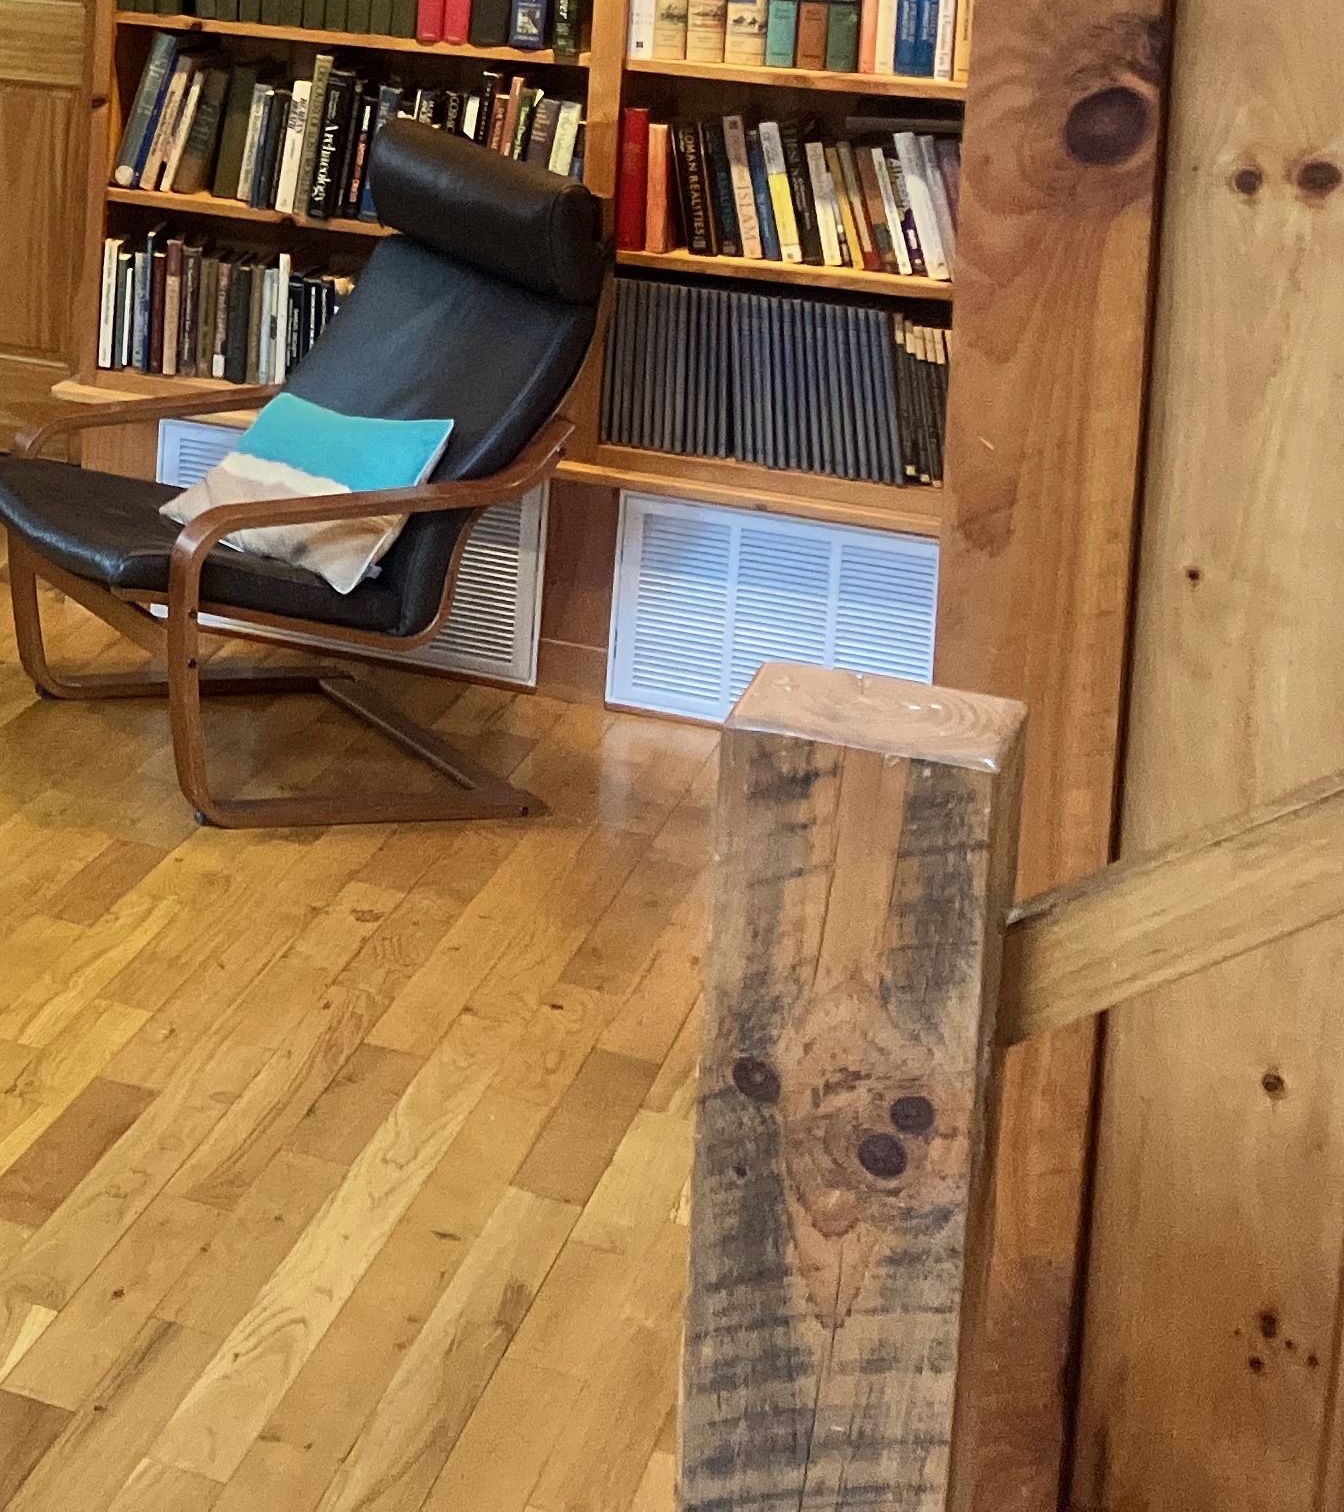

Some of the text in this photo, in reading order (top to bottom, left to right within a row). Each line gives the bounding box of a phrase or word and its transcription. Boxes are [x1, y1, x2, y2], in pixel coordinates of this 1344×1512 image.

[311, 122, 339, 202] Archaeology
[683, 128, 705, 235] ROMAN REALITIES
[736, 186, 757, 241] ISLAM
